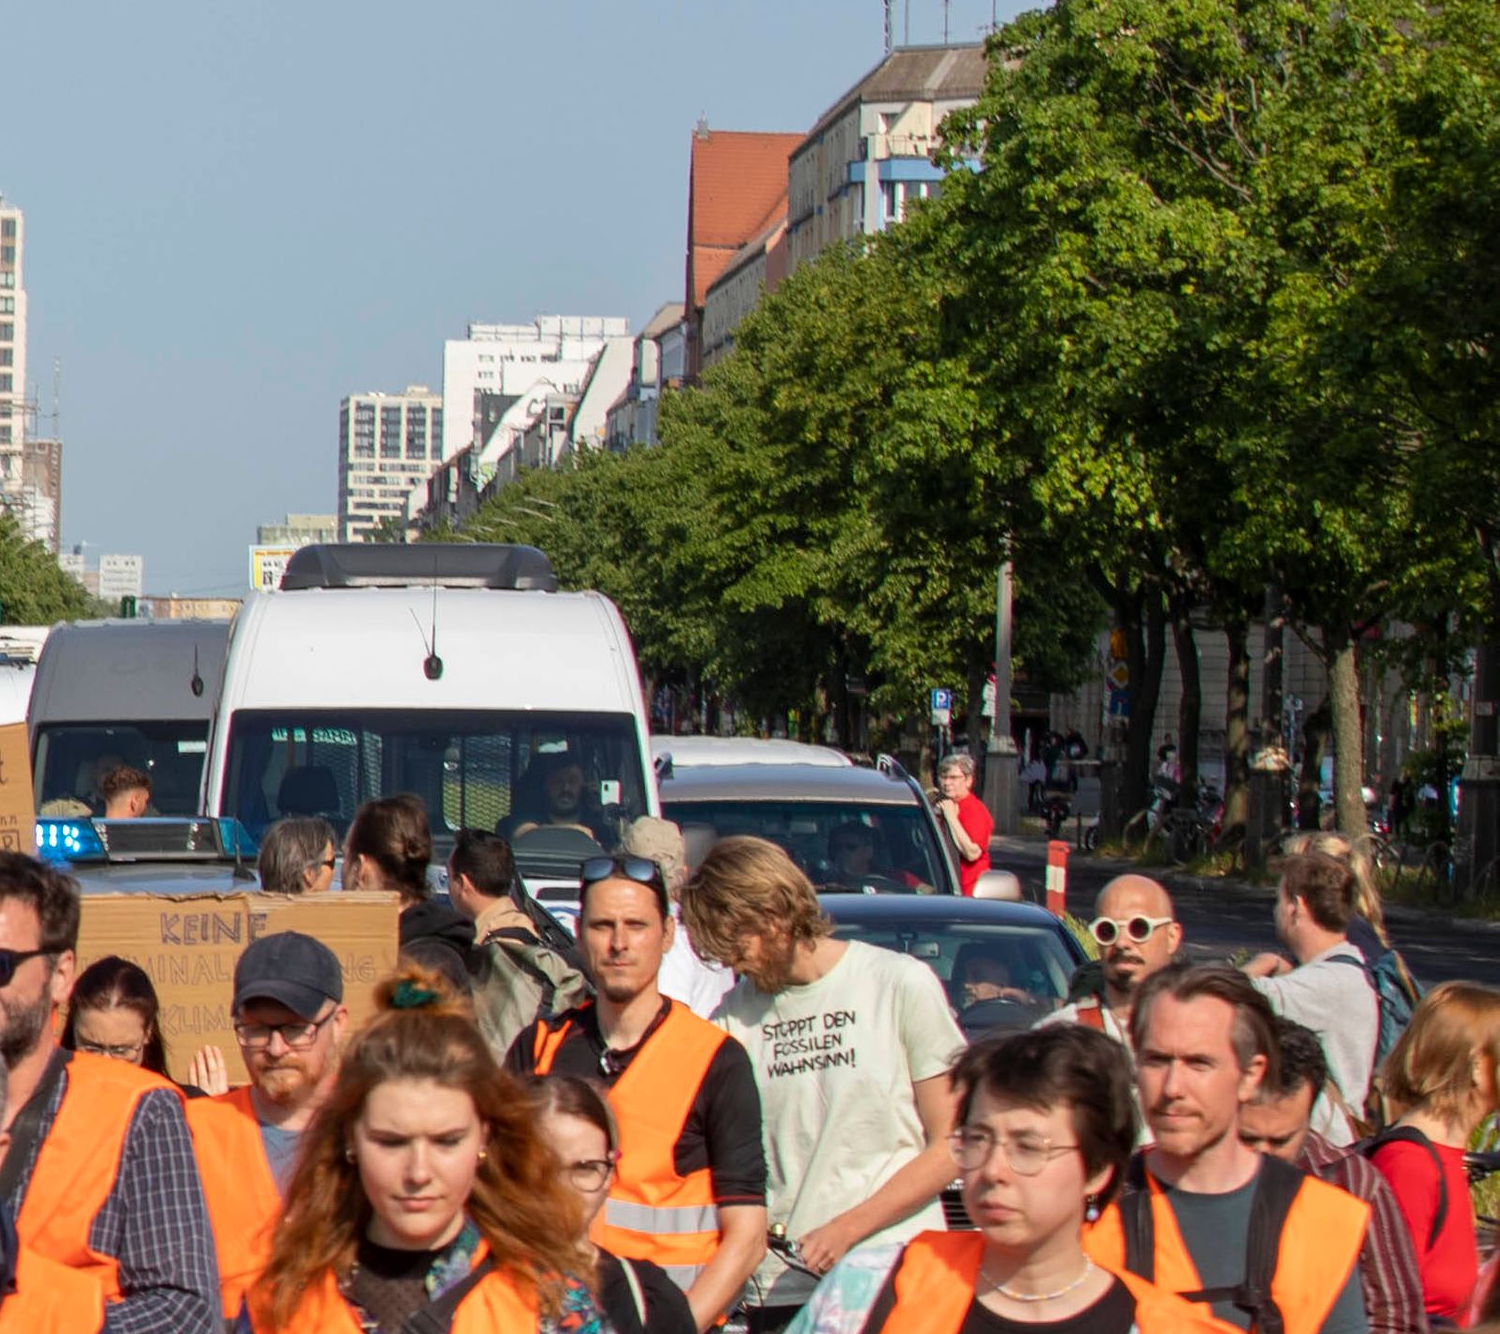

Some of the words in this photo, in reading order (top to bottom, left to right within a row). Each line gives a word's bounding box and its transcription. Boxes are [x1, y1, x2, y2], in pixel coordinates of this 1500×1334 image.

[160, 912, 268, 945] KEINE
[762, 1015, 817, 1042] STOPPT
[823, 1011, 856, 1030] DEN
[773, 1033, 842, 1060] FOSSILEN
[767, 1048, 856, 1079] WAHNSINN!
